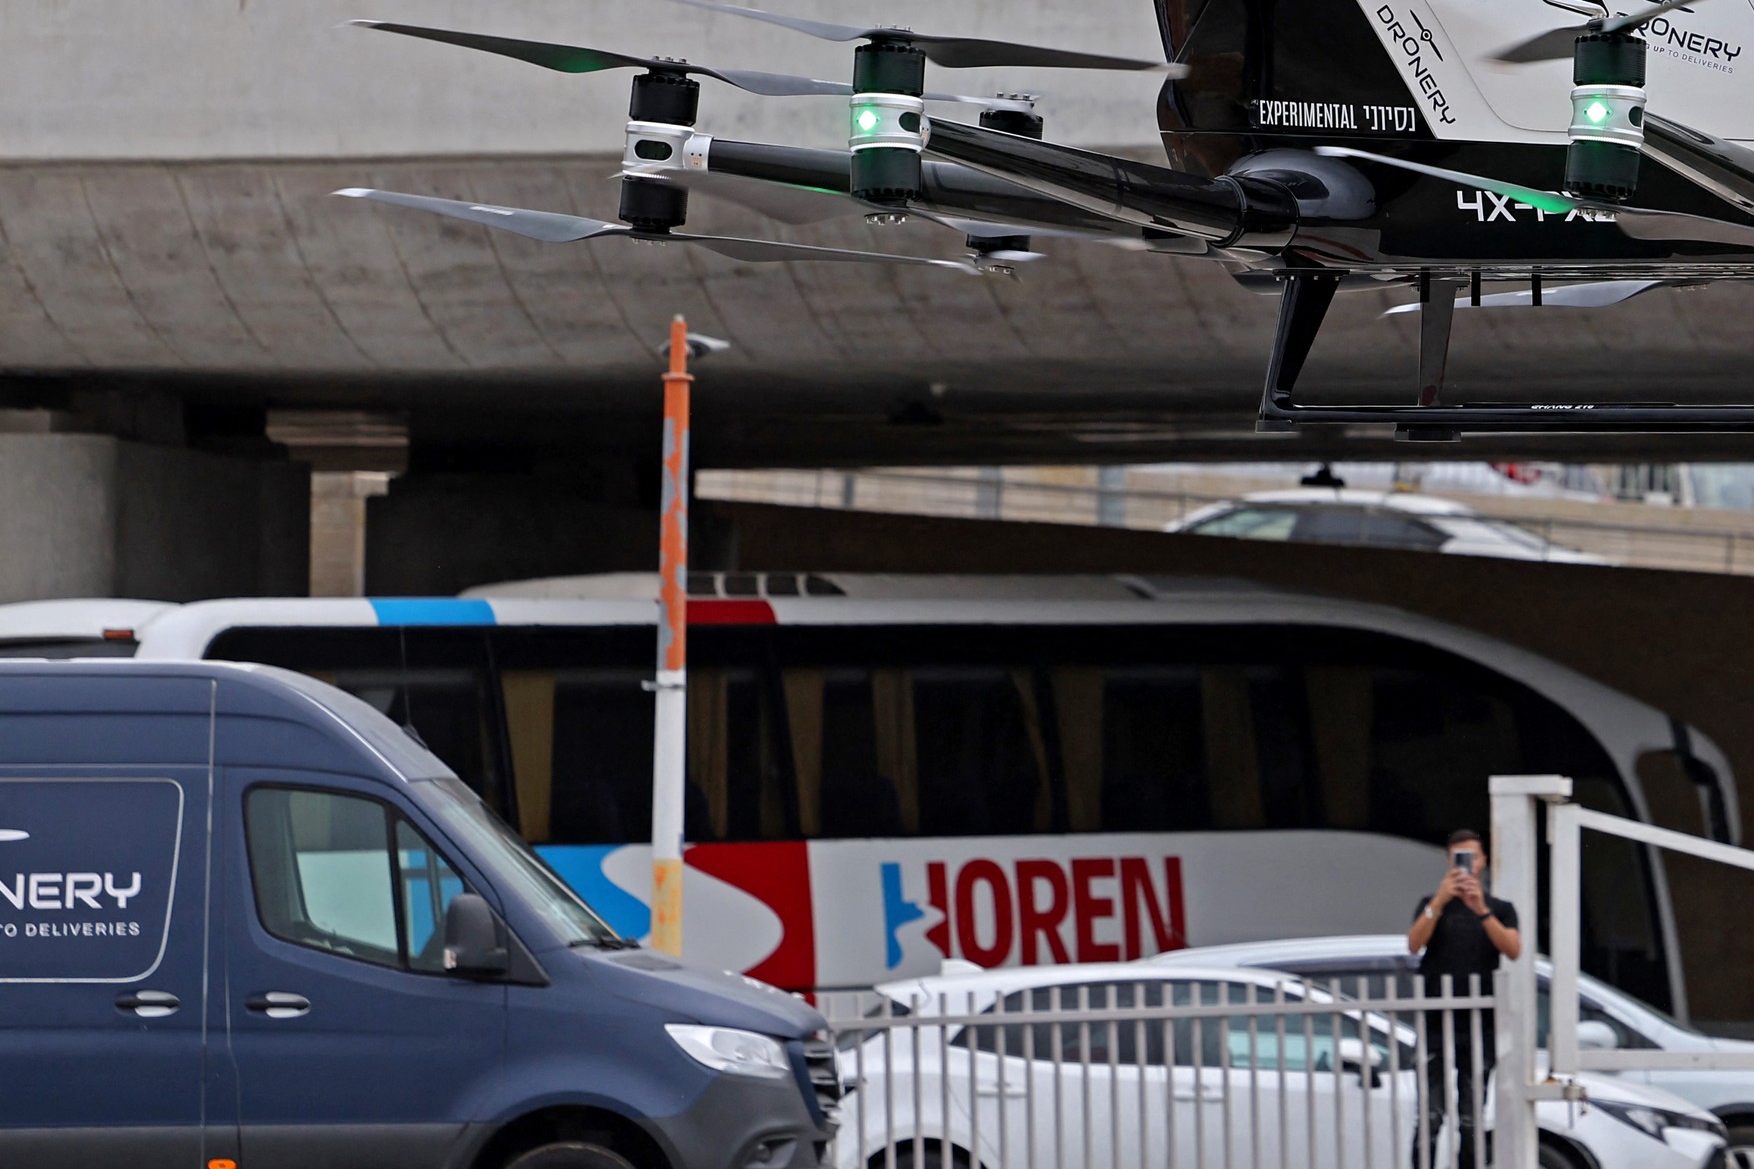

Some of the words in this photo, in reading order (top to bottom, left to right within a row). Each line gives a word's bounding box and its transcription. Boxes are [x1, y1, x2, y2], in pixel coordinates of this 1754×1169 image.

[1616, 11, 1742, 62] RONERY
[1376, 4, 1457, 125] DRONERY
[1653, 44, 1665, 53] UP
[1668, 49, 1679, 58] TO
[1682, 53, 1734, 75] DELIVERIES
[1259, 99, 1358, 130] EXPERIMENTAL
[1362, 105, 1416, 132] נסיוני
[25, 920, 141, 938] DELIVERIES
[880, 853, 1190, 971] HOREN
